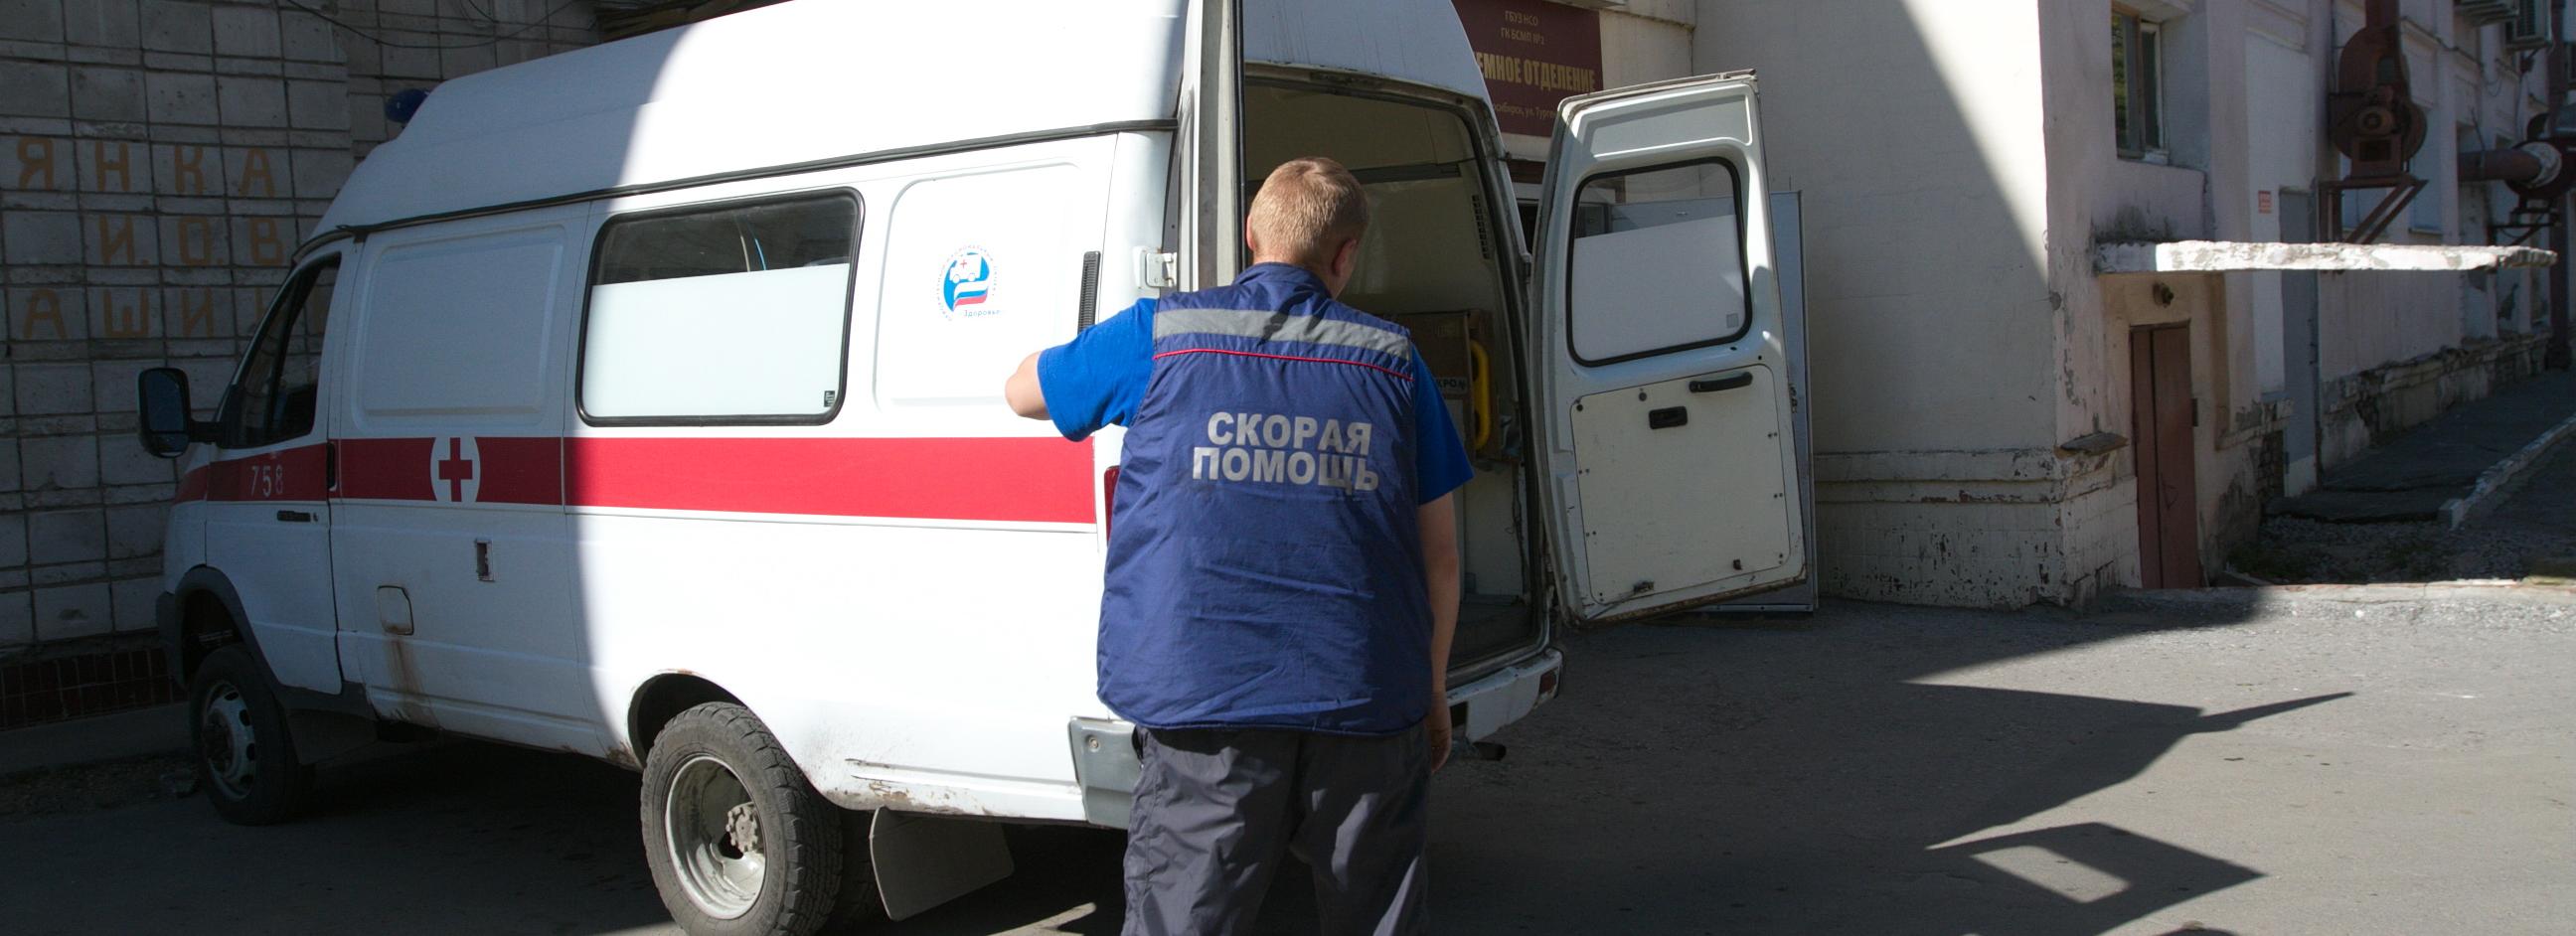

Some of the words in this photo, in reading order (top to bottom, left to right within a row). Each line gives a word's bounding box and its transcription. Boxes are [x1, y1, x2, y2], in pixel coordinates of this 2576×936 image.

[1524, 58, 1595, 92] ОТДЕЛЕНИЕ
[17, 137, 275, 197] ЯНКА
[1208, 411, 1371, 456] СКОРАЯ
[250, 464, 283, 498] 758
[1193, 447, 1378, 495] ПОМОЩЬ
